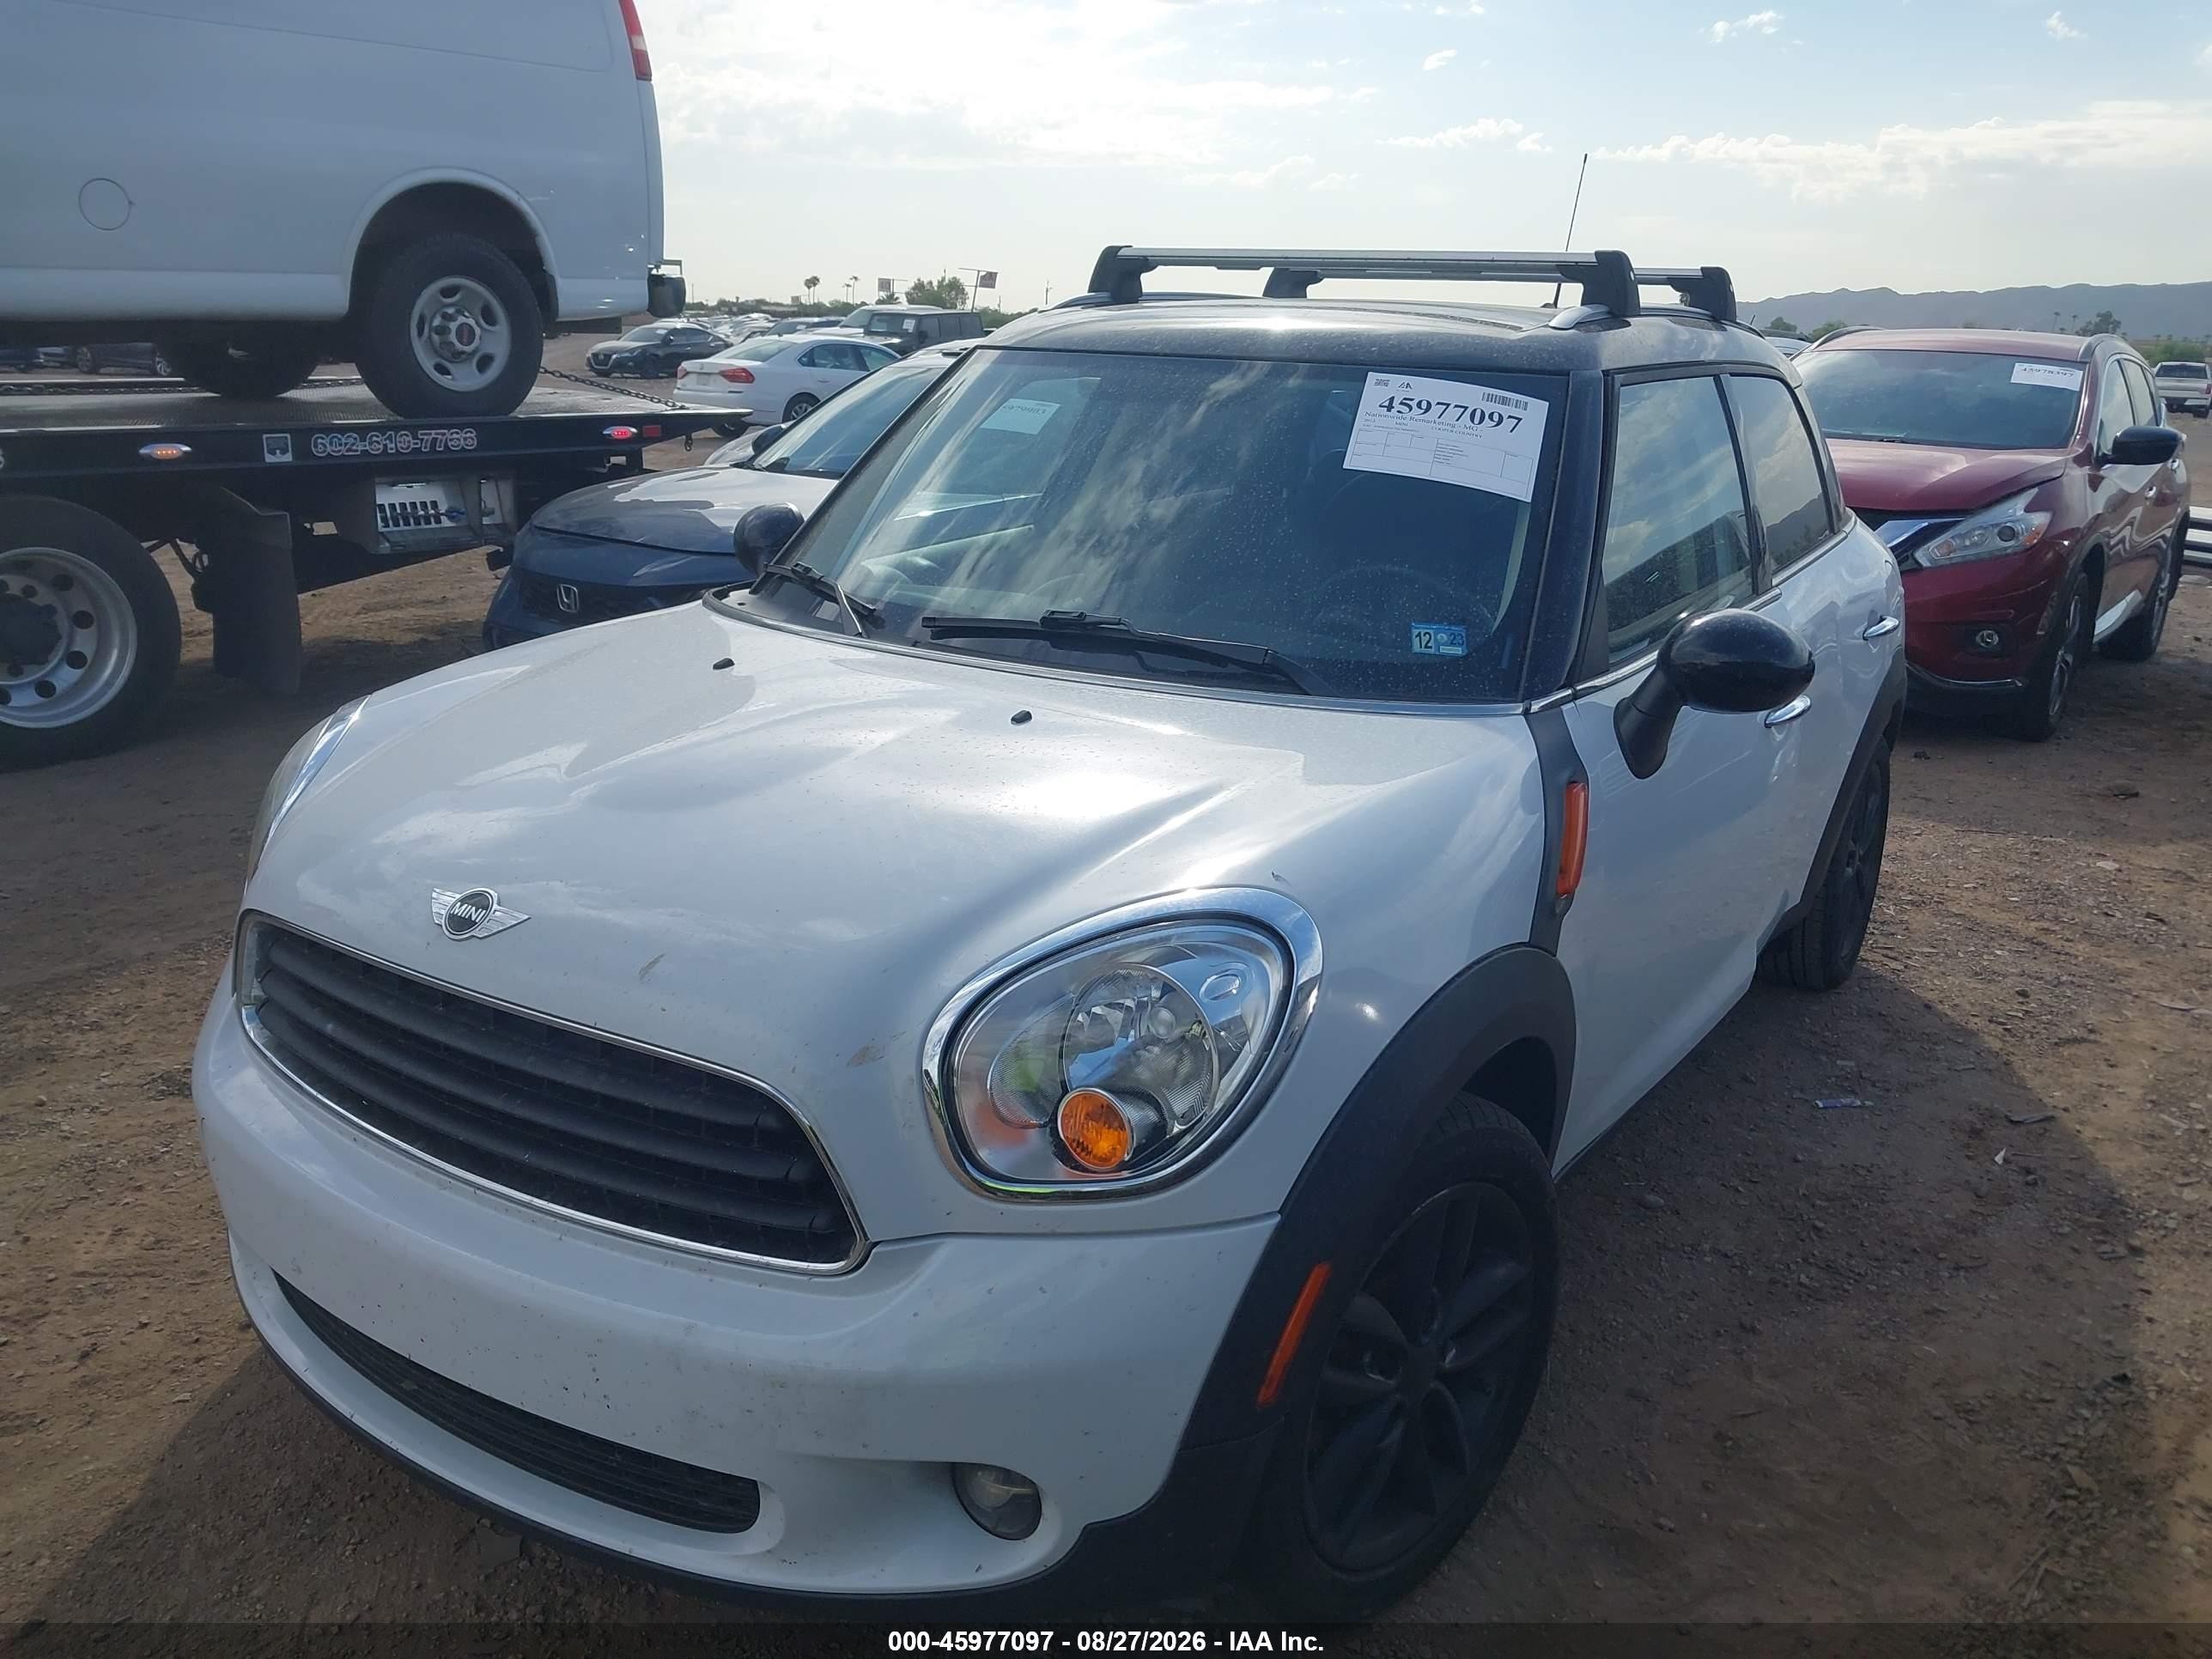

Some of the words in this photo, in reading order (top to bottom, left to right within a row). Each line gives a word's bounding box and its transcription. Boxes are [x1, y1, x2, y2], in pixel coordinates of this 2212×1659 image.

[1364, 411, 1407, 421] Nationwide
[1409, 416, 1456, 428] Remarketing
[1378, 396, 1523, 434] 45977097
[1414, 630, 1433, 649] 12
[450, 902, 487, 923] MINI
